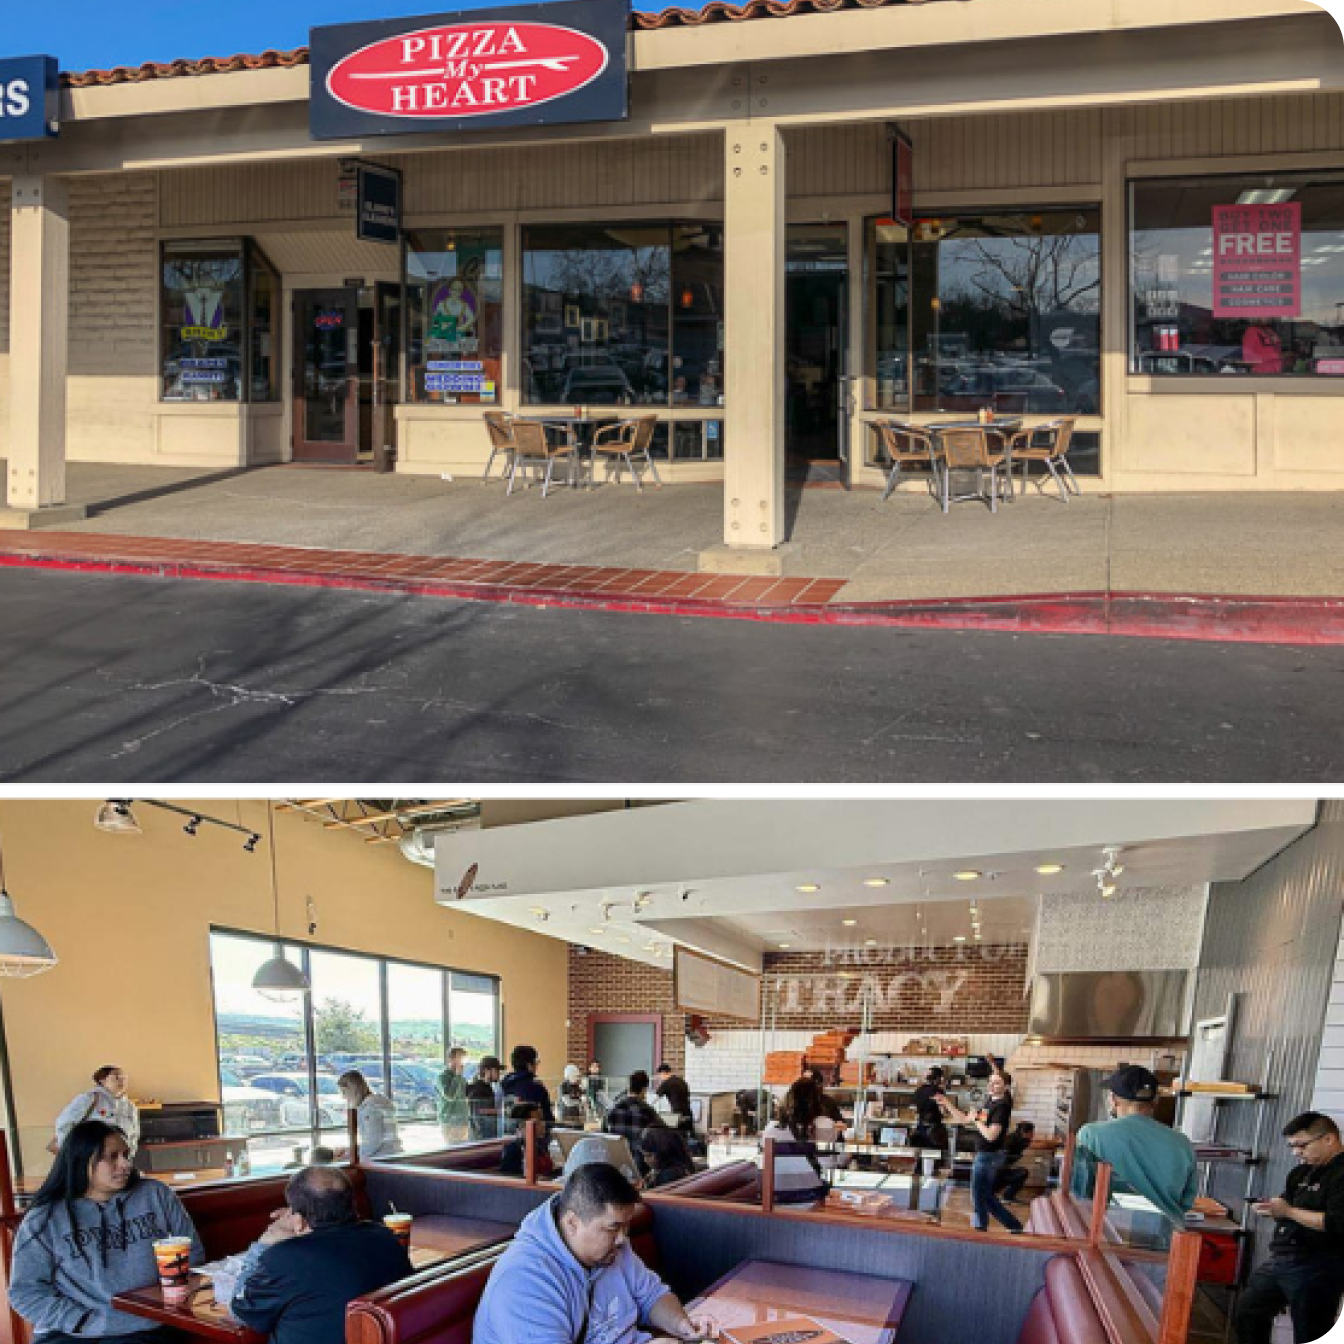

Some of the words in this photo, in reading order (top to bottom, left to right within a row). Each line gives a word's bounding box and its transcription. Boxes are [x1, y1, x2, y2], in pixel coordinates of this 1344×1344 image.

[400, 26, 527, 63] PIZZA
[443, 60, 485, 81] My
[391, 75, 536, 112] HEART
[1218, 210, 1252, 220] BUY
[1258, 209, 1293, 219] TWO
[1219, 221, 1252, 232] GET
[1258, 220, 1293, 231] ONE
[1219, 232, 1294, 255] FREE
[776, 970, 970, 1013] TRACY
